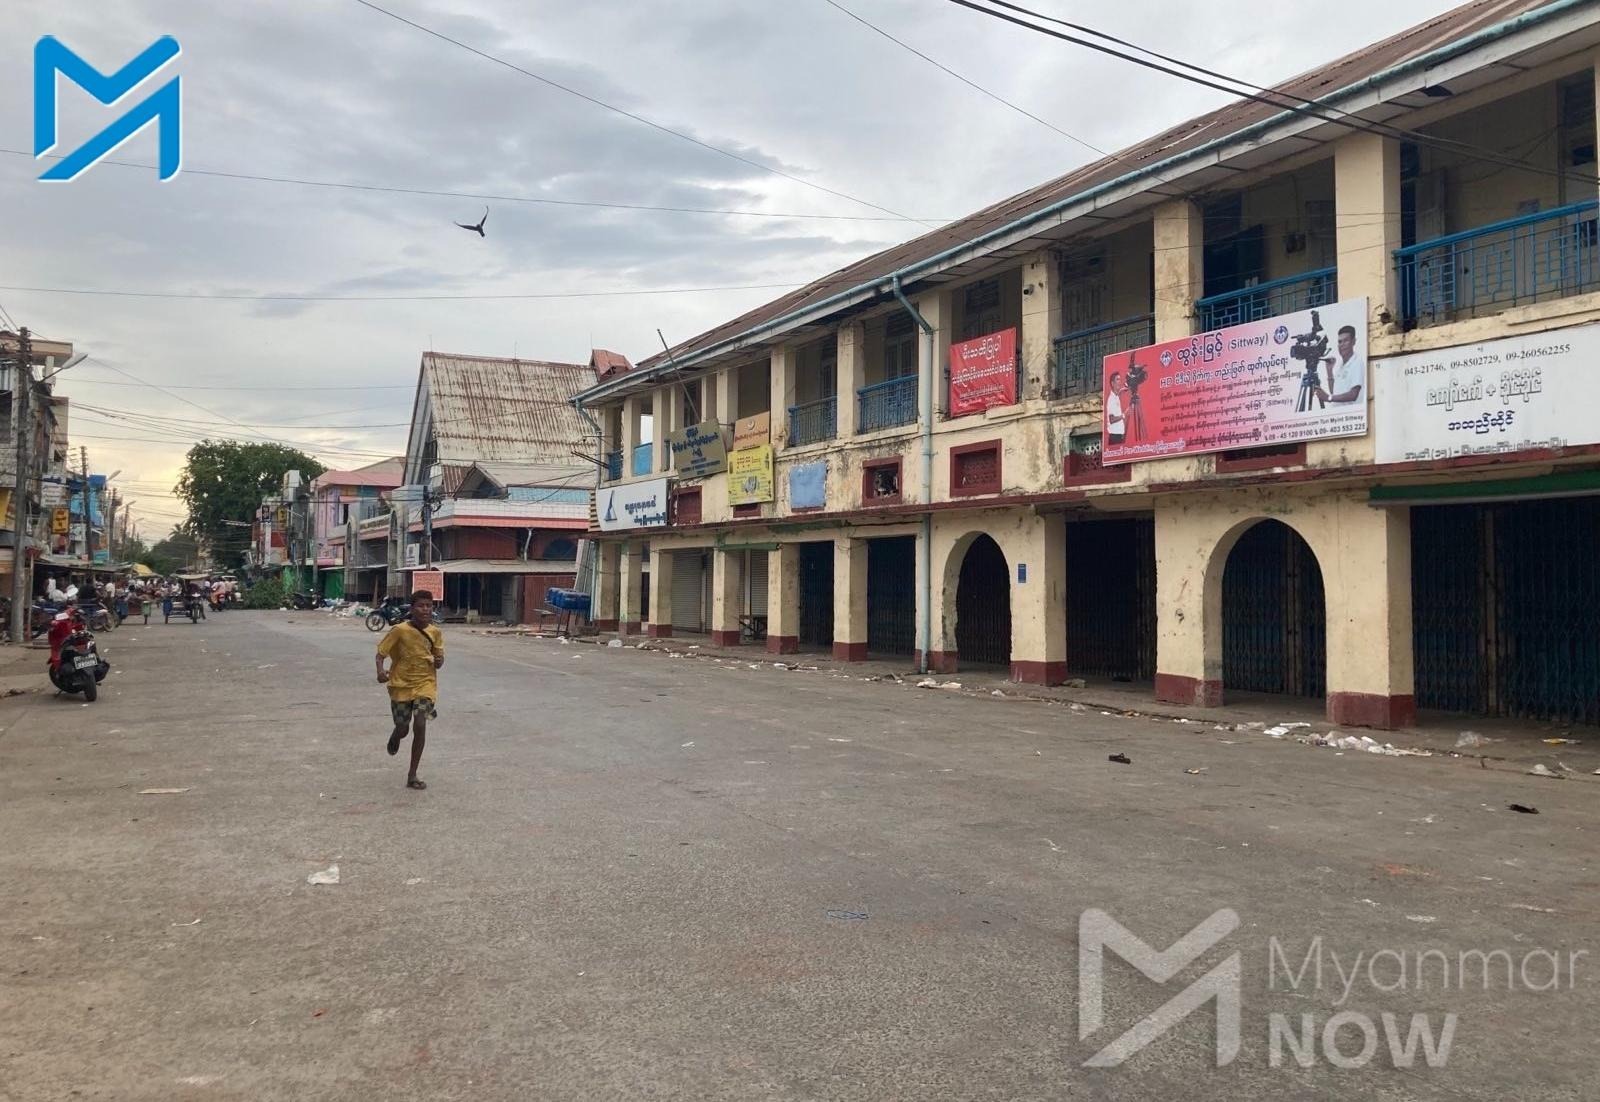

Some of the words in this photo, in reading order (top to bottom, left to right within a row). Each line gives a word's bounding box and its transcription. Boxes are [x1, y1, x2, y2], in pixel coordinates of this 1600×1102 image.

[1227, 332, 1269, 352] (Sittway)
[1448, 410, 1515, 434] အထည်ဆိုင်
